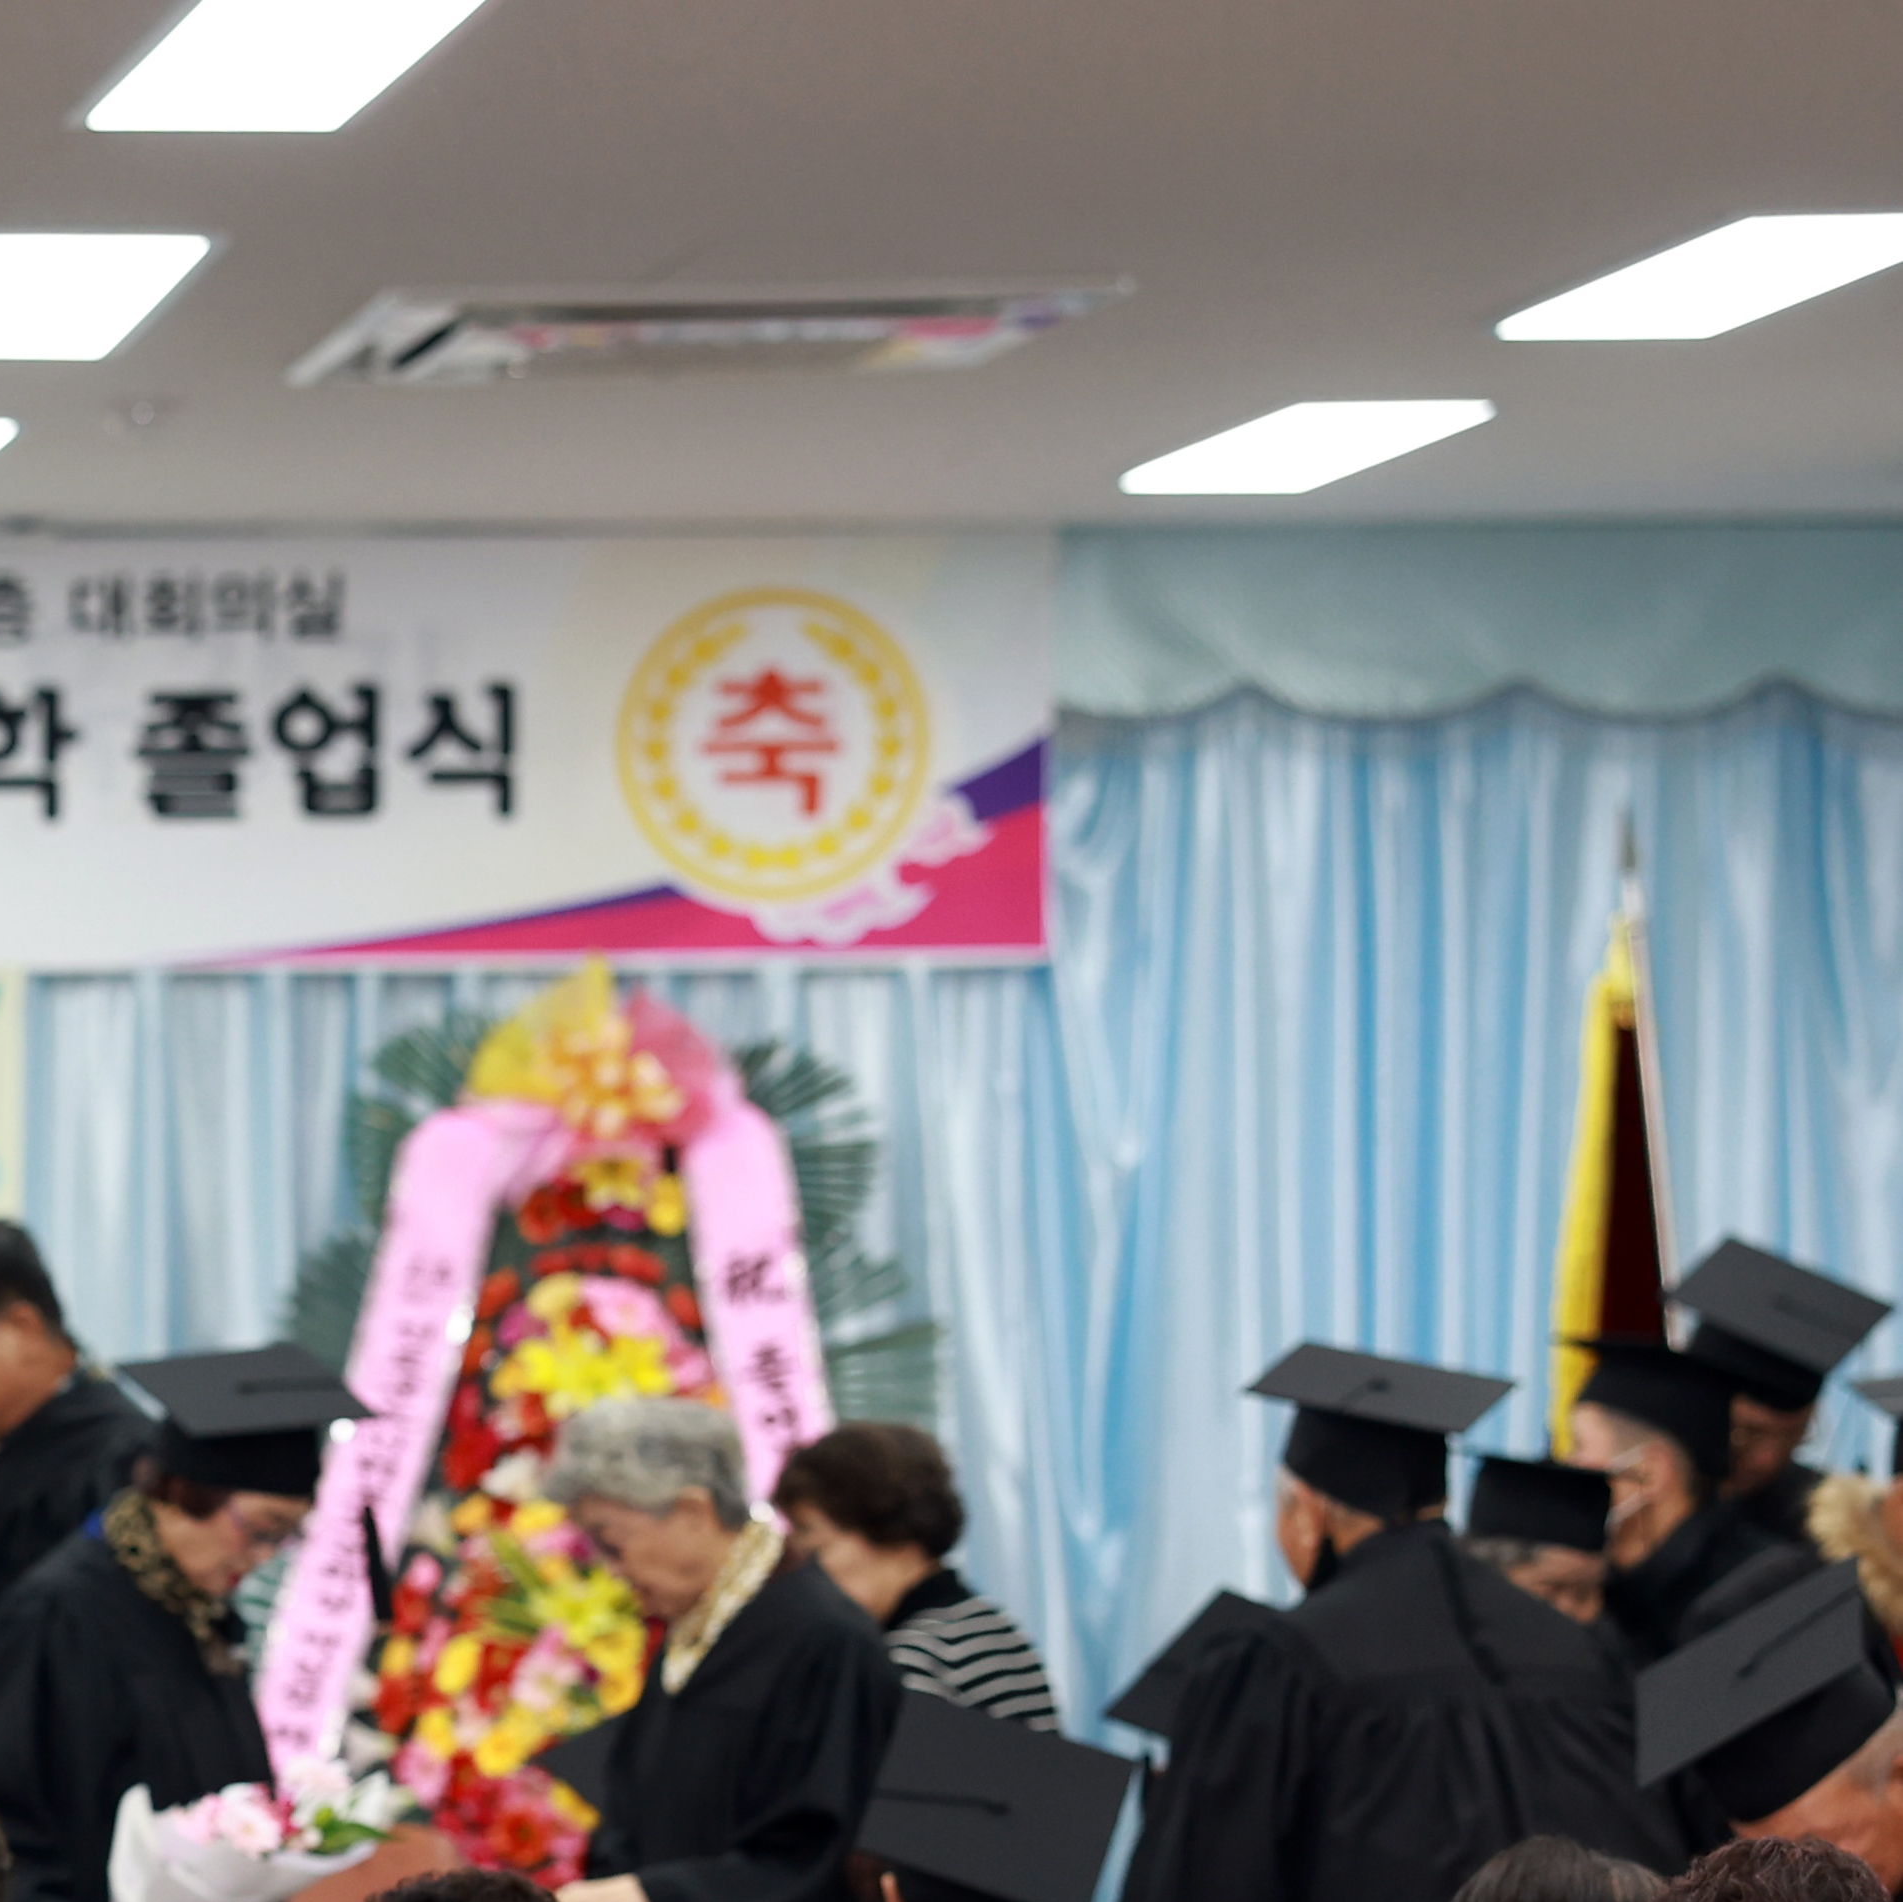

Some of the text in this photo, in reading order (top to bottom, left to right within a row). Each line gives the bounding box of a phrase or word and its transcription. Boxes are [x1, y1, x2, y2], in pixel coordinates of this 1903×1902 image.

[67, 568, 347, 648] 대회의실
[135, 682, 520, 822] 졸업식
[701, 664, 841, 820] 축
